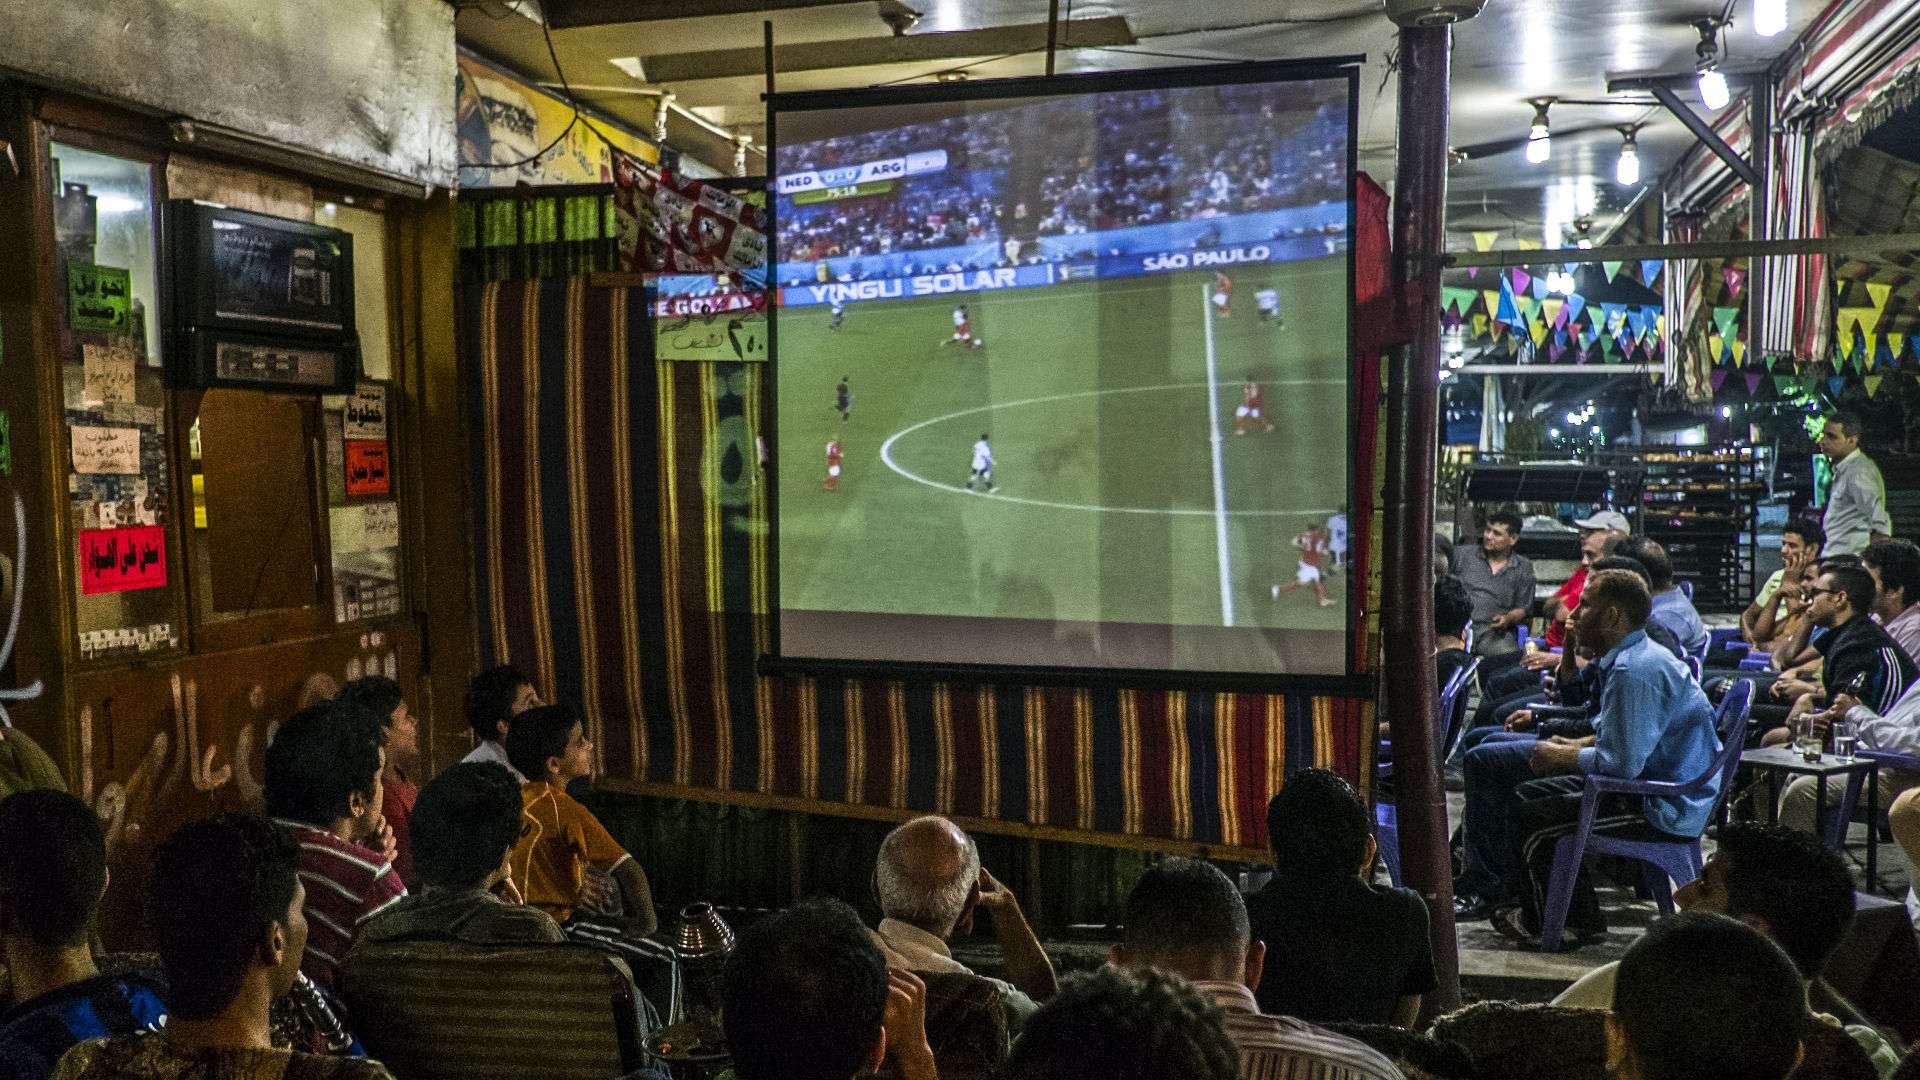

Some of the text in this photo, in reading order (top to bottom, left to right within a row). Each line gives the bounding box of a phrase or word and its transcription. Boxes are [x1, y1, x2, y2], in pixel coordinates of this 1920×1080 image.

[785, 176, 813, 188] NED
[871, 162, 901, 176] ARG
[1143, 245, 1271, 271] SÃO PAULO
[912, 268, 1017, 296] SOLAR
